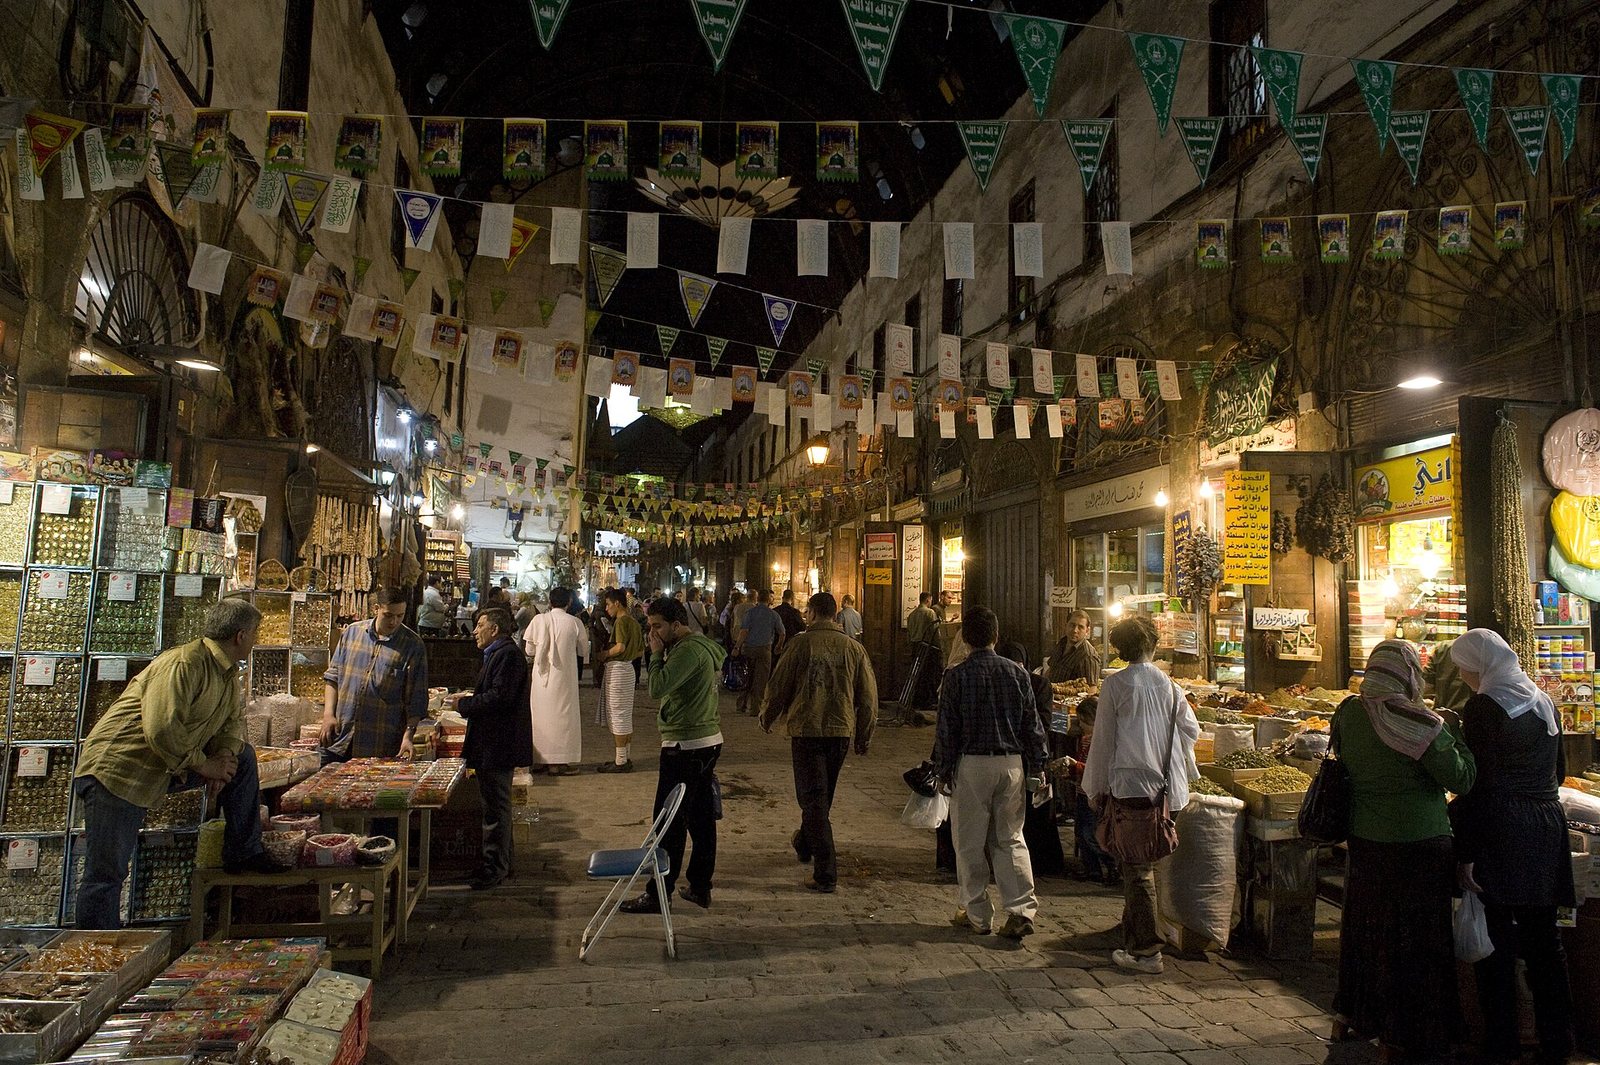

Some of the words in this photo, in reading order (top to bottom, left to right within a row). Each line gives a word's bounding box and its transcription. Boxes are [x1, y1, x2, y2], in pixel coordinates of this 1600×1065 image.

[703, 11, 730, 29] رسول
[854, 18, 890, 34] محمد
[861, 36, 885, 53] رسول
[1248, 484, 1269, 492] كراوية
[1249, 504, 1269, 512] بهارات
[1250, 522, 1269, 531] بهارات
[1250, 533, 1269, 541] بهارات
[1250, 543, 1269, 551] بهارات
